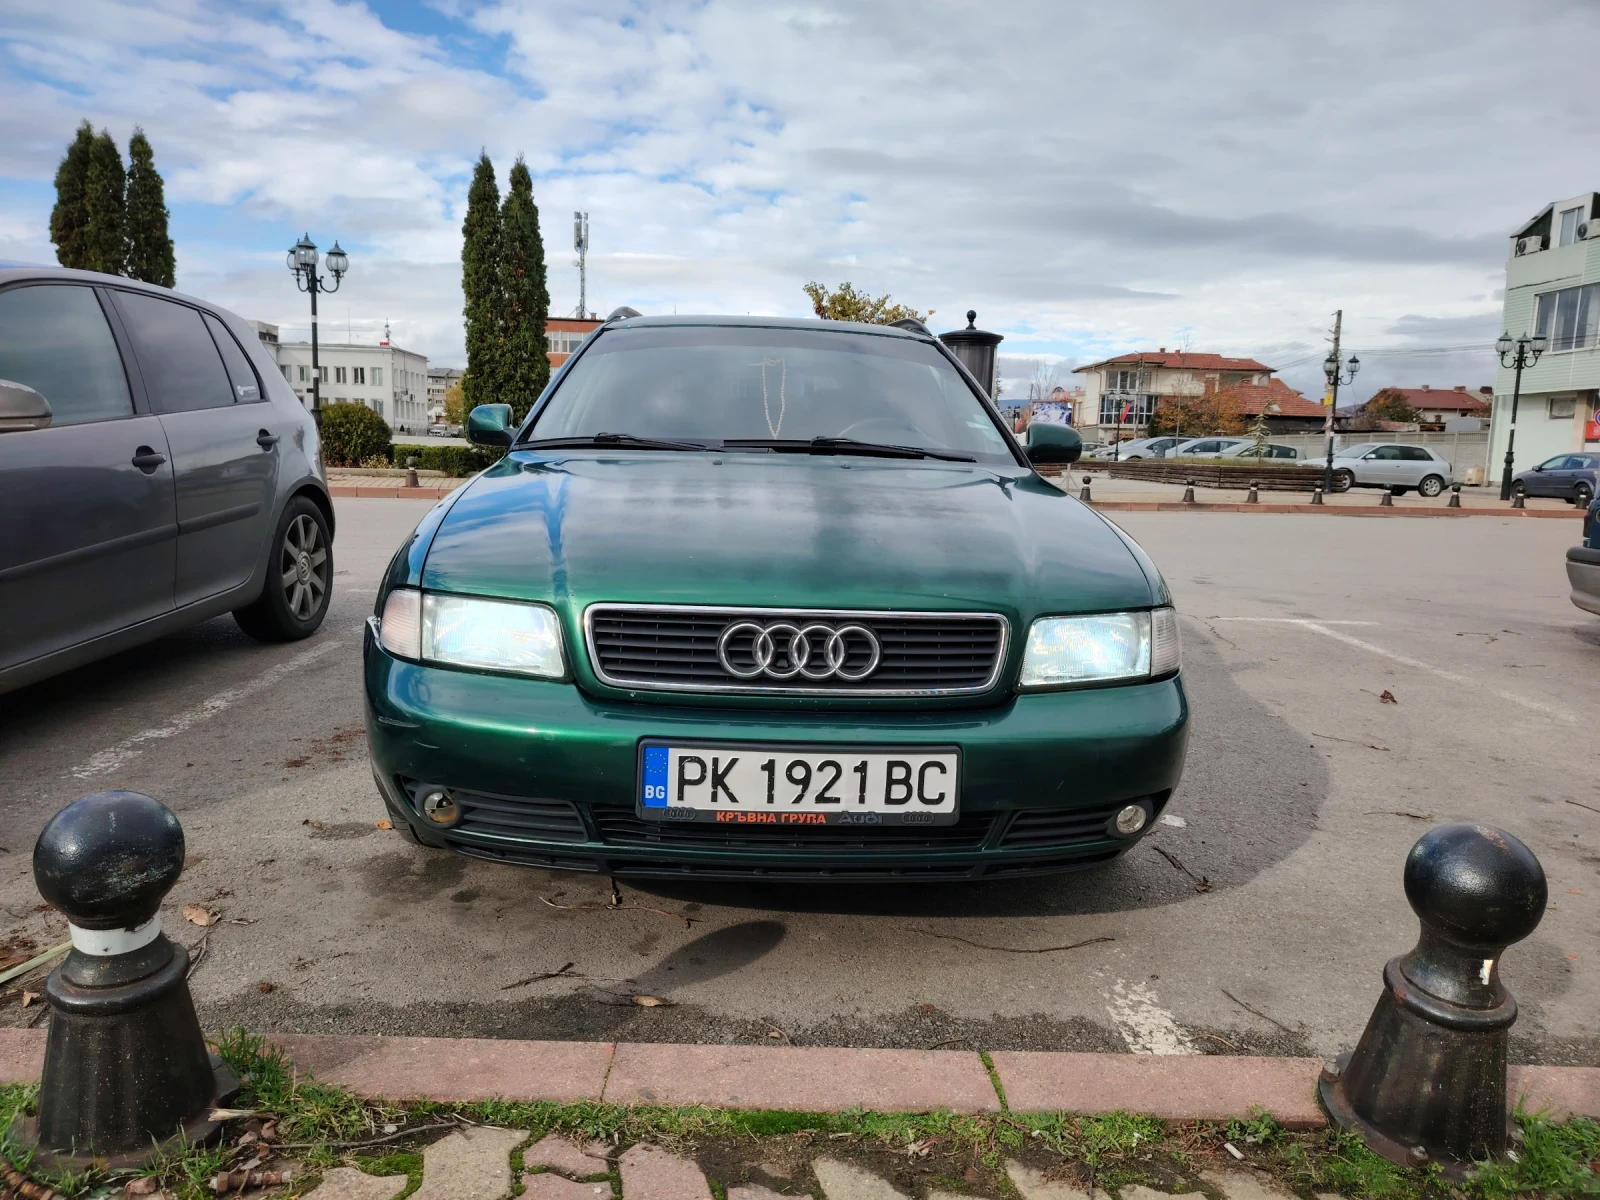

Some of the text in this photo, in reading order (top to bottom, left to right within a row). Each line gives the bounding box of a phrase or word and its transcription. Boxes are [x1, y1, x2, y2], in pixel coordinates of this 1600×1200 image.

[677, 755, 948, 806] PK 1921 BC
[645, 784, 666, 800] BG
[716, 811, 827, 825] КРЪВНА ГРУПА
[838, 811, 883, 824] Audi
